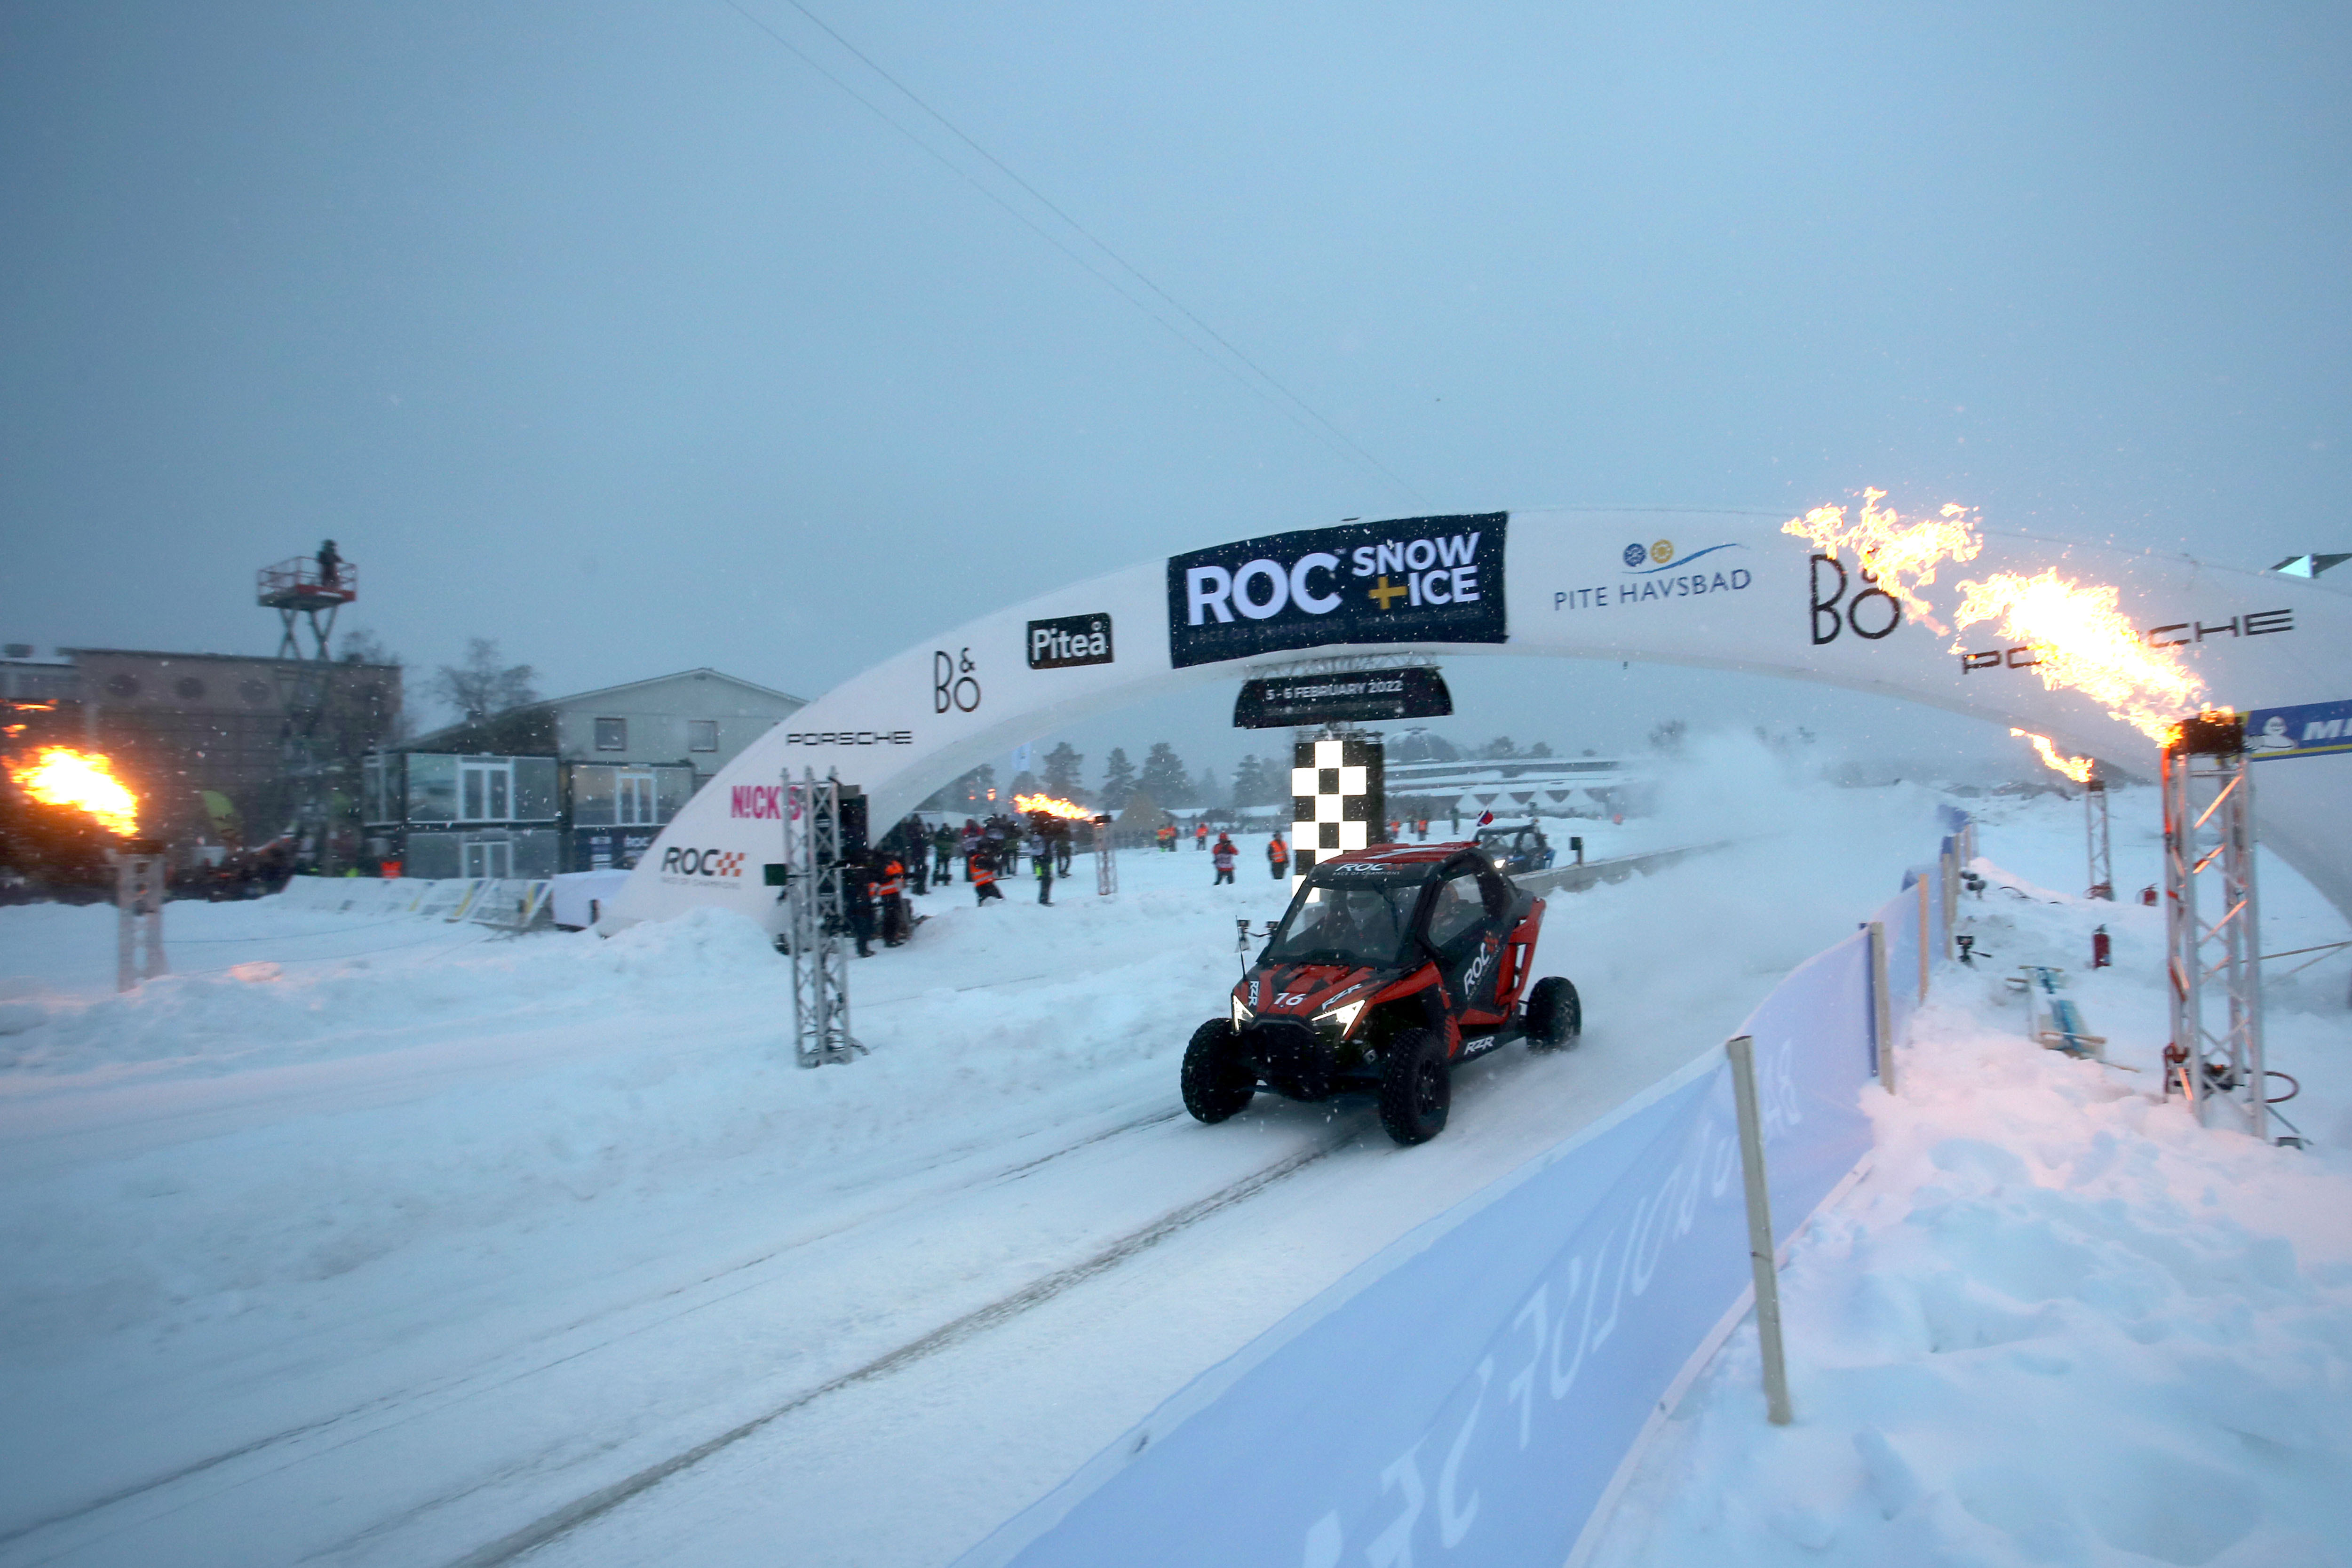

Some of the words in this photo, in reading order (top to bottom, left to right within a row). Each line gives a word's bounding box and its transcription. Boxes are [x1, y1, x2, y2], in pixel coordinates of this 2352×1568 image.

[1351, 532, 1481, 576] SNOW
[1186, 552, 1343, 626] ROC
[1408, 565, 1480, 606] ICE
[1554, 587, 1609, 611] PITE
[1620, 569, 1751, 604] HAVSBAD
[1032, 621, 1106, 660] Piteå
[1962, 608, 2293, 675] POCHE
[1265, 689, 1275, 700] 5
[1283, 688, 1293, 699] 6
[1294, 683, 1366, 699] FEBRUARY
[1367, 680, 1403, 693] 2022
[787, 731, 913, 746] PORSCHE
[660, 846, 721, 876] ROC
[1335, 863, 1392, 871] ROC
[1464, 942, 1490, 995] ROC
[1248, 981, 1260, 1006] RZR
[1273, 992, 1306, 1005] 16
[1322, 983, 1362, 1011] RZR
[1464, 1036, 1495, 1055] RZR
